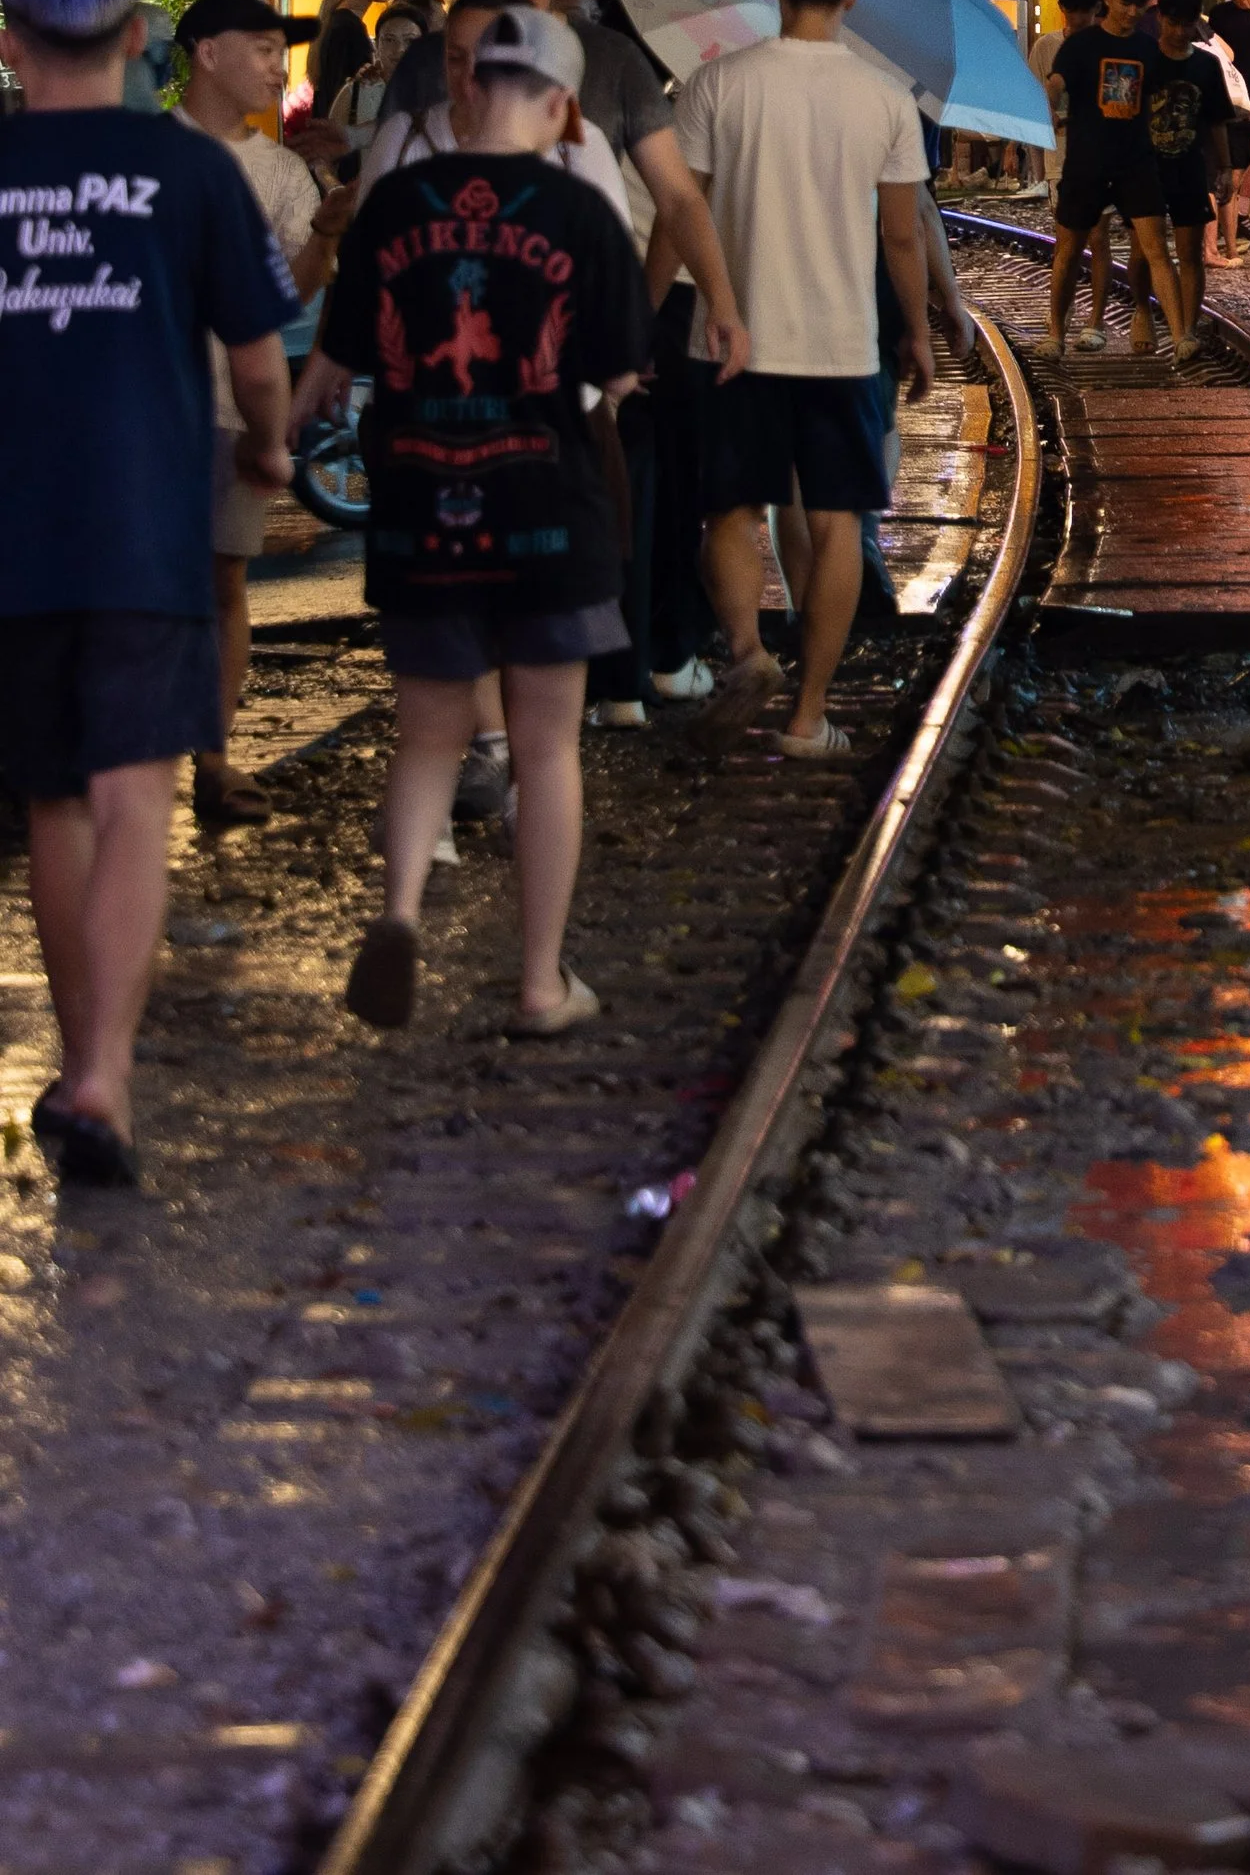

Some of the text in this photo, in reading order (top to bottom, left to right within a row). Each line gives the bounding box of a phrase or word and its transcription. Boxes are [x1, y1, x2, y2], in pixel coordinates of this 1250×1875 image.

[75, 172, 160, 217] PAZ
[17, 217, 95, 259] Univ.
[377, 220, 575, 284] MIKENCO
